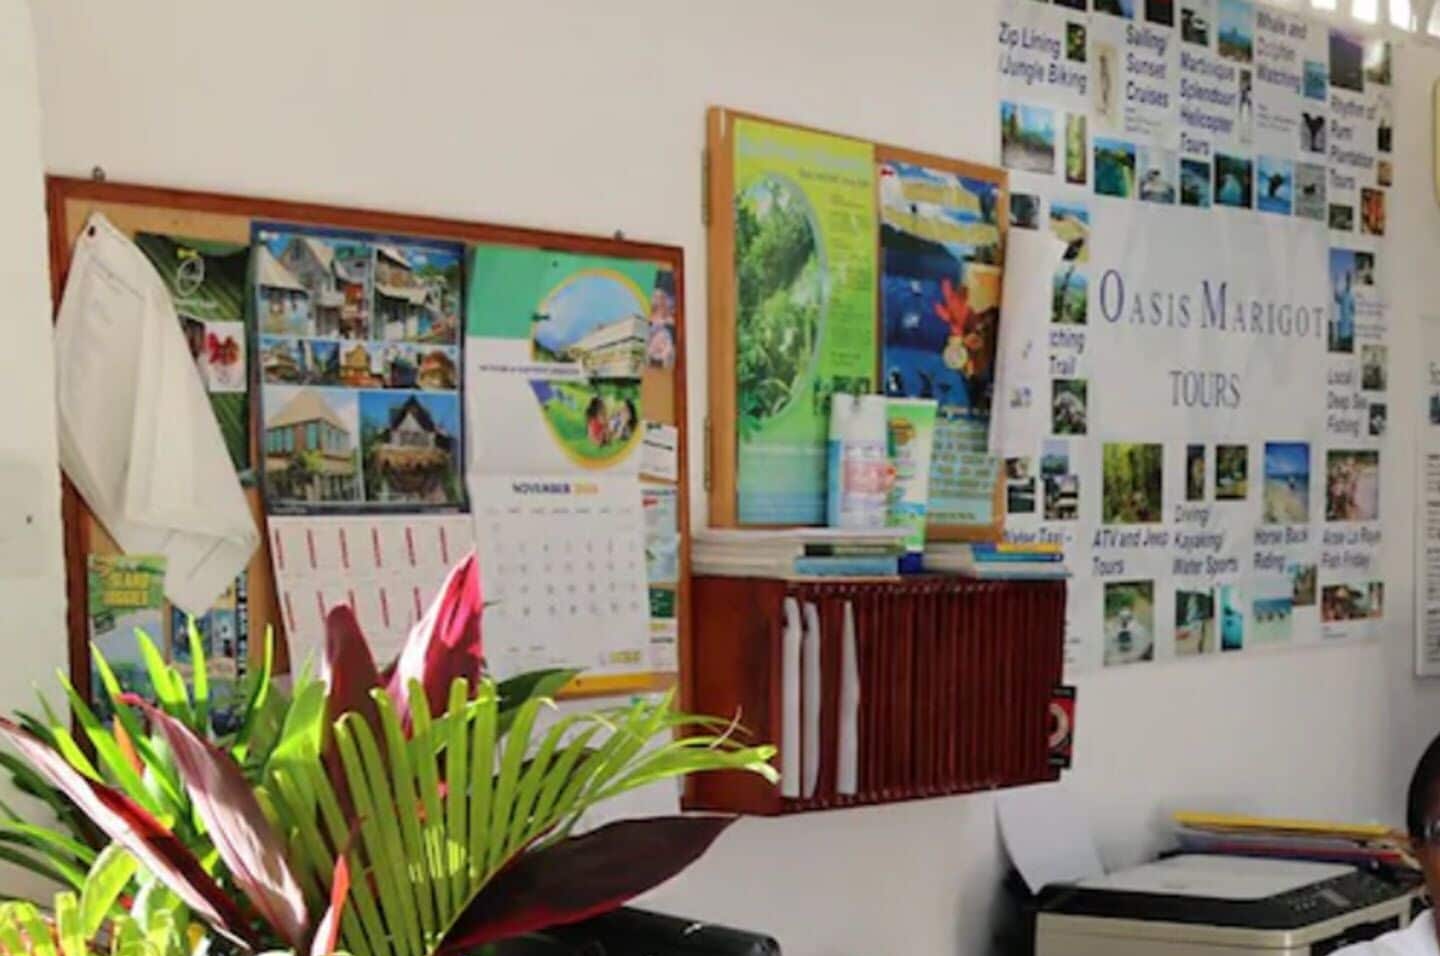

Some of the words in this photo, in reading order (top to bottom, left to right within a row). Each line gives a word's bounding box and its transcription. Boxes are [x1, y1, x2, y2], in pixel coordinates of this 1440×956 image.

[998, 21, 1019, 48] Zip
[1022, 28, 1061, 60] Lining
[1048, 63, 1087, 96] Biking
[1126, 52, 1168, 80] Sunset
[1126, 80, 1169, 109] Cruises
[1180, 132, 1209, 156] Tours
[1100, 268, 1191, 329] OASIS
[1200, 279, 1324, 340] MARIGOT
[1168, 369, 1242, 409] TOURS
[512, 481, 571, 496] NOVEMBER
[1093, 555, 1125, 576] Tours
[1172, 557, 1202, 576] Water
[1204, 554, 1238, 578] Sports
[1253, 551, 1286, 574] Riding
